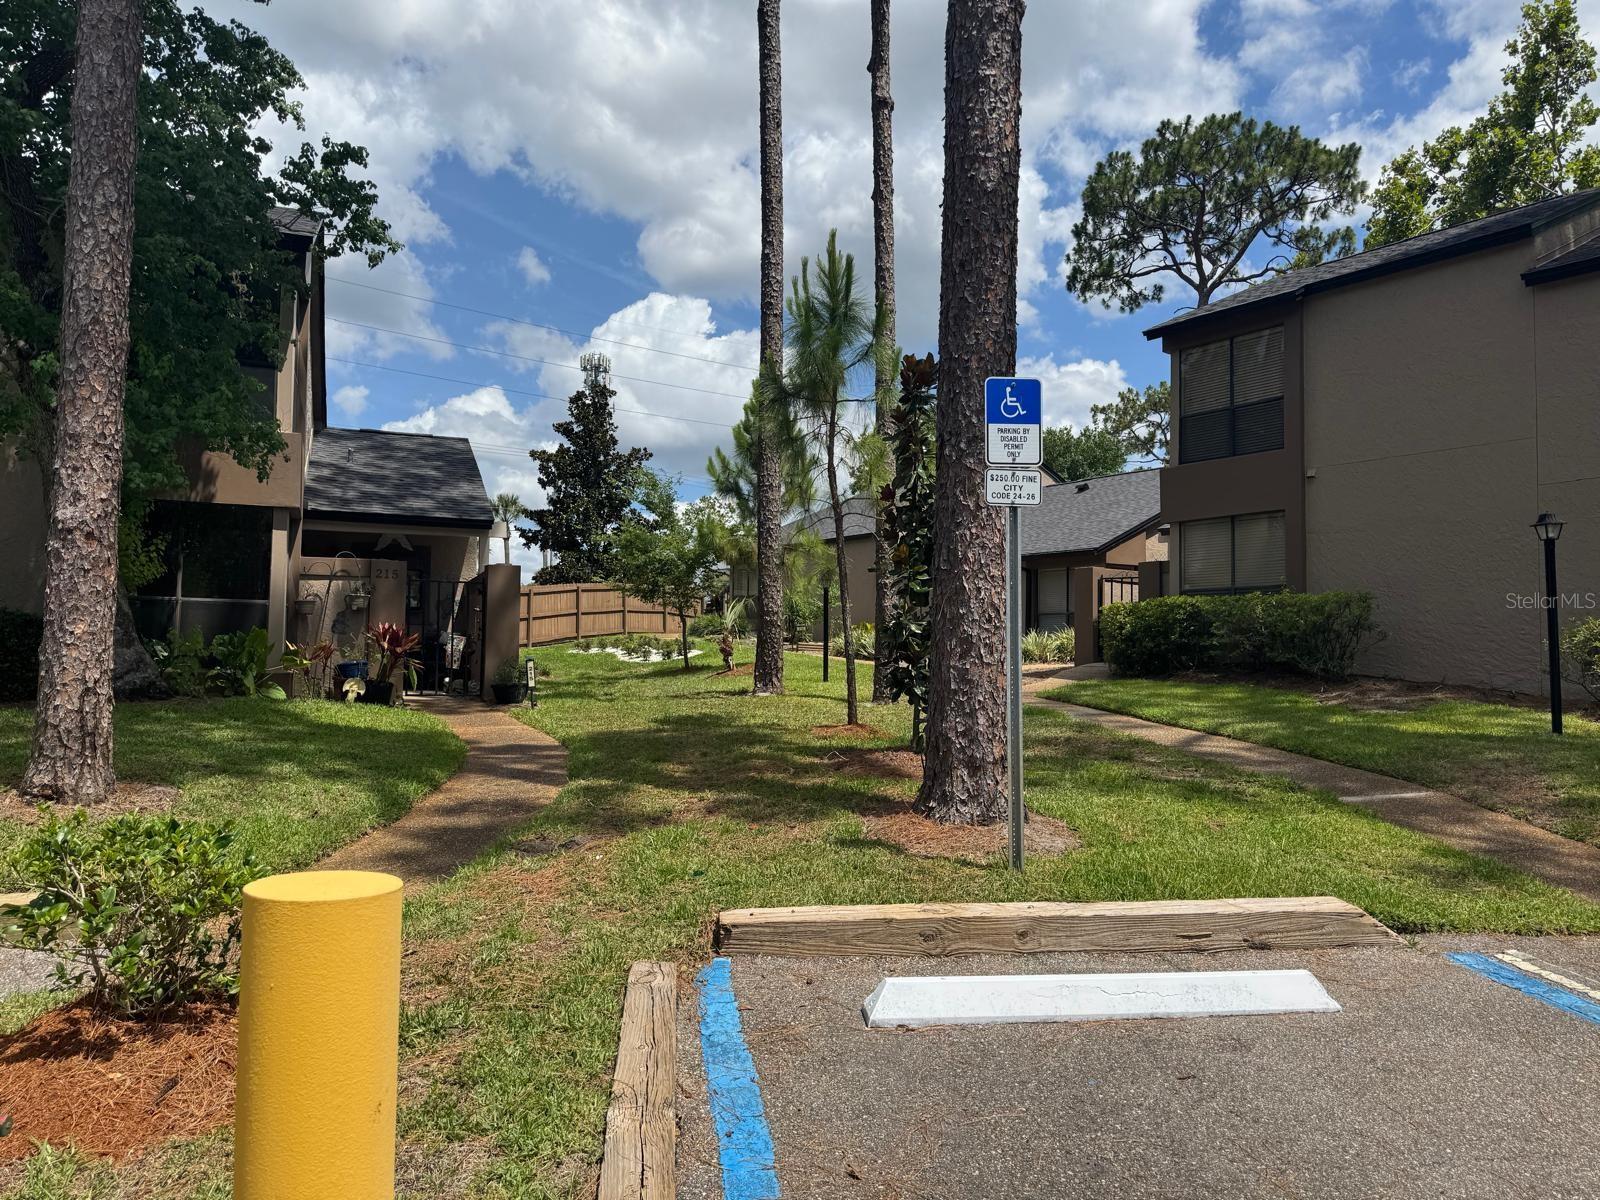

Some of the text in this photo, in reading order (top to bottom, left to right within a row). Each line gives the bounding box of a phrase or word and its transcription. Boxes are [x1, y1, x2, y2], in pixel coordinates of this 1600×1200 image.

[990, 474, 1037, 483] $250.00 FINE
[376, 568, 400, 579] 215
